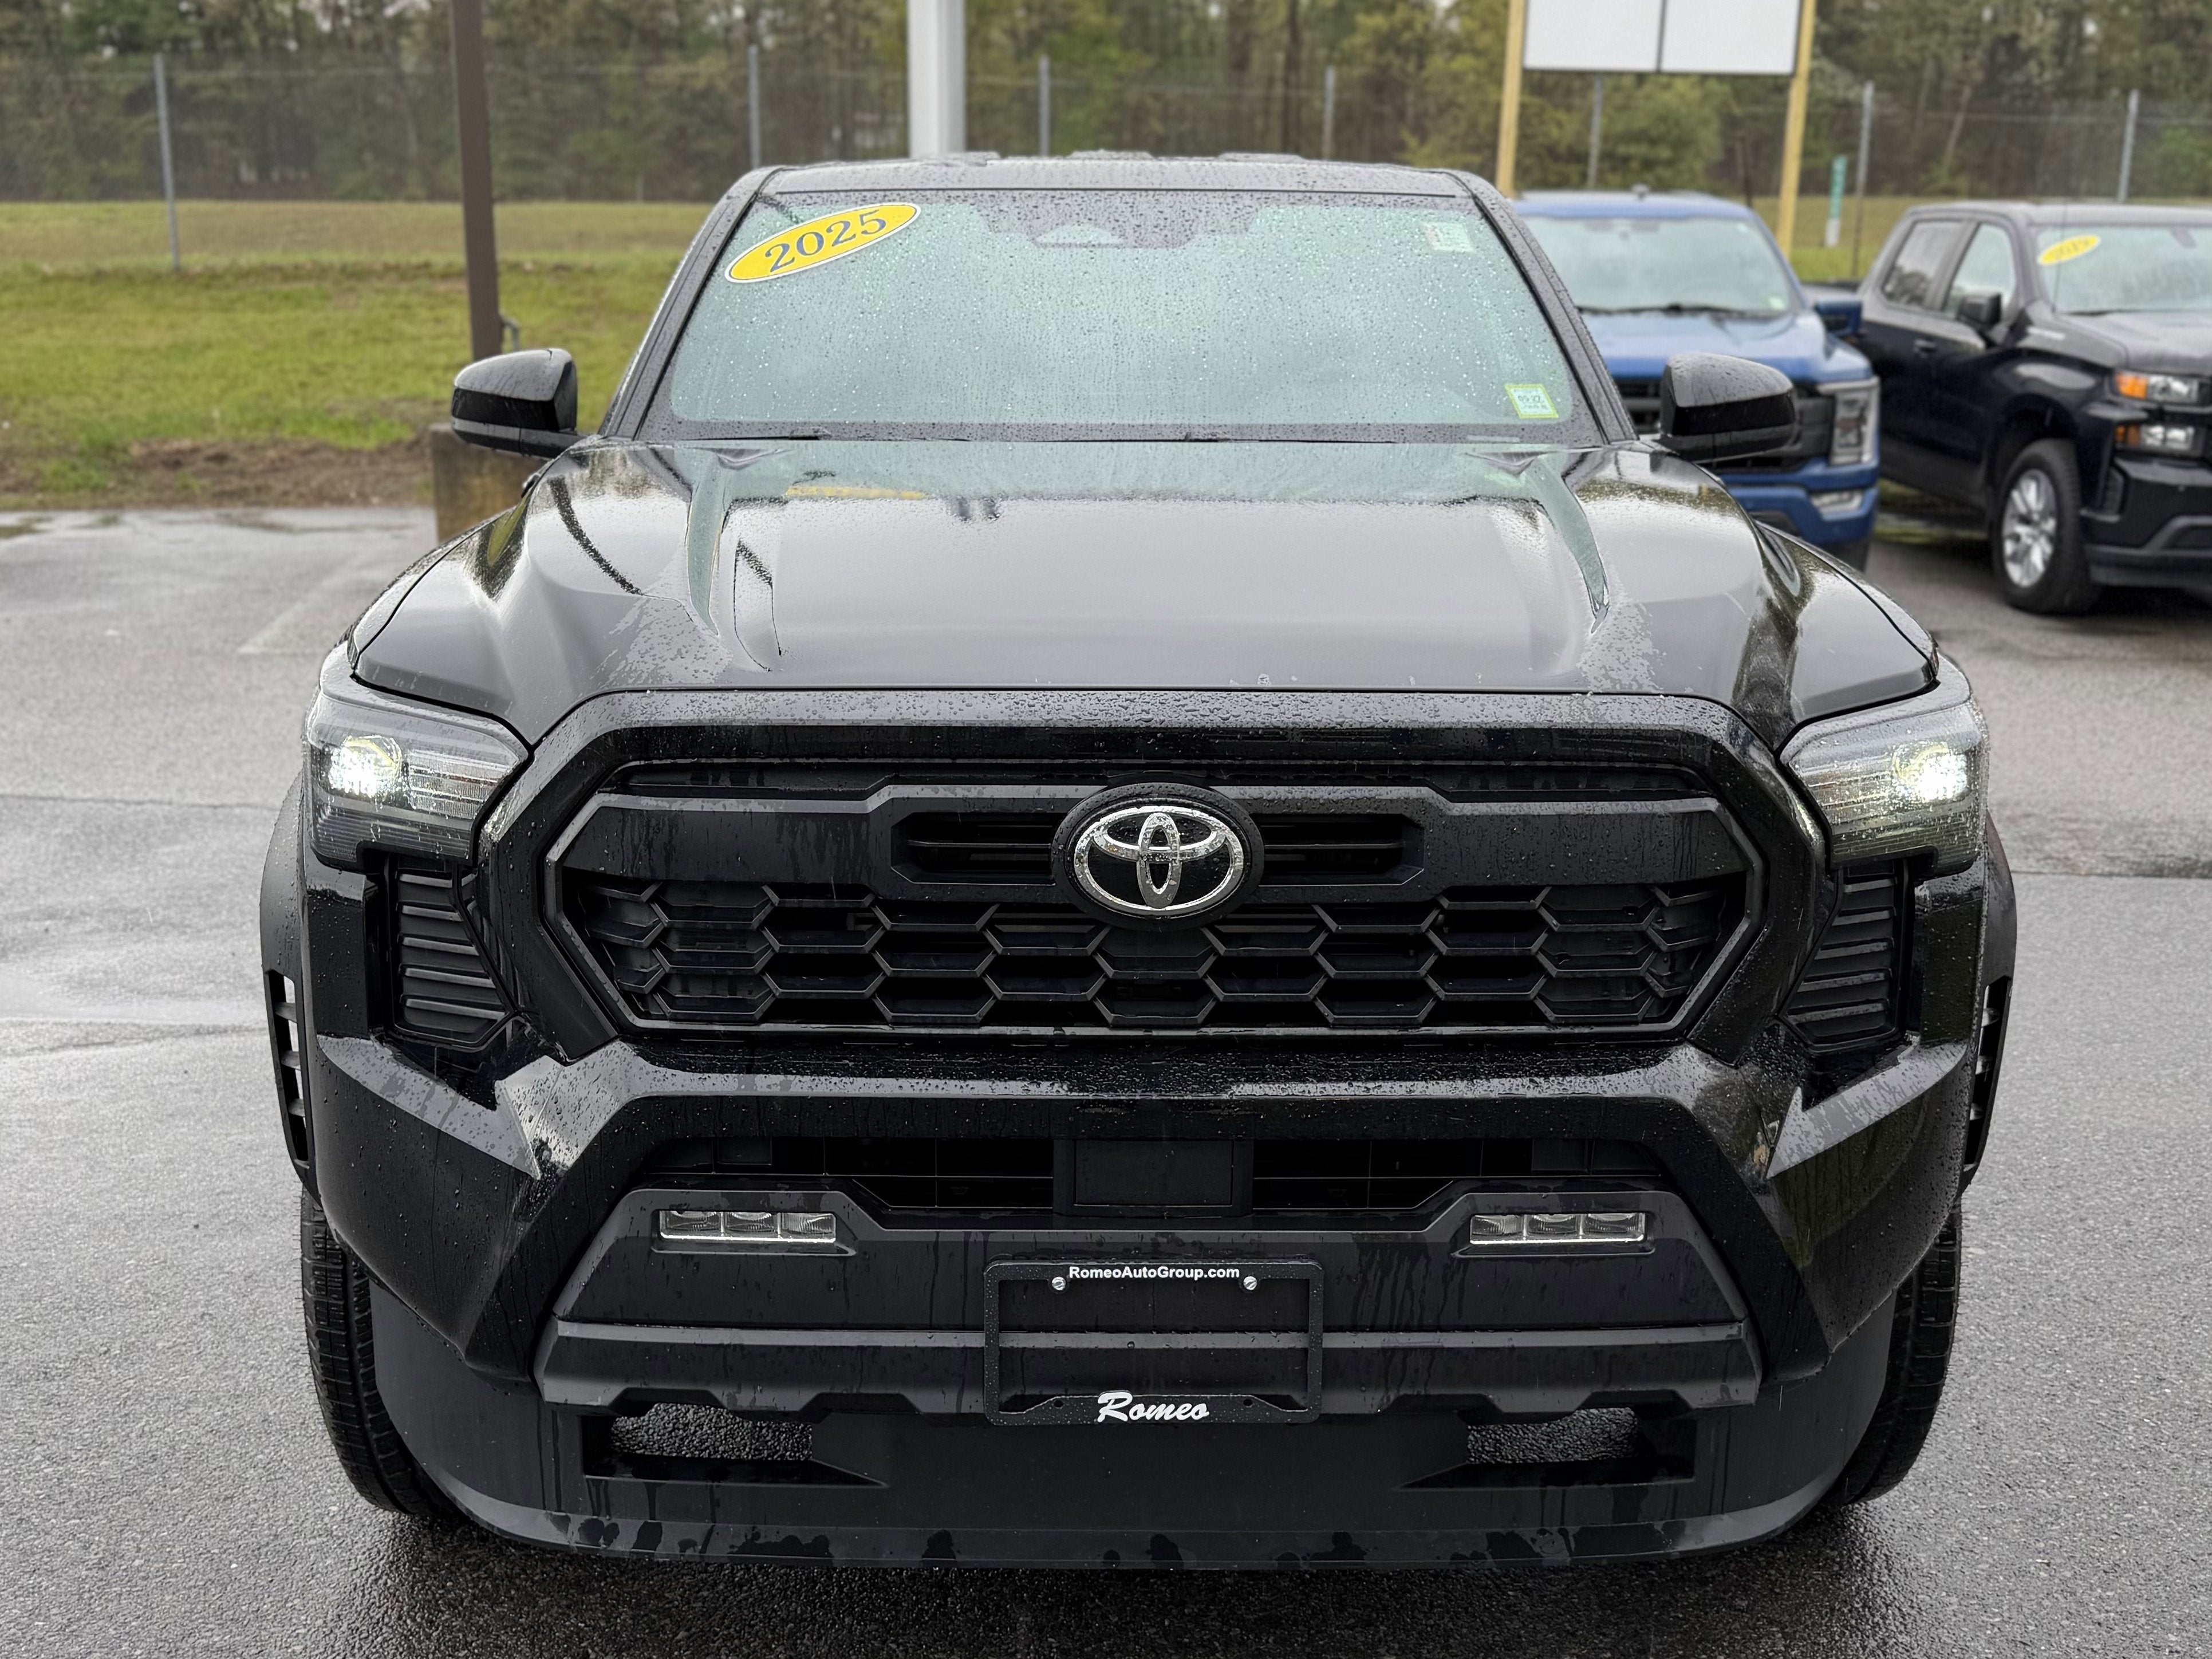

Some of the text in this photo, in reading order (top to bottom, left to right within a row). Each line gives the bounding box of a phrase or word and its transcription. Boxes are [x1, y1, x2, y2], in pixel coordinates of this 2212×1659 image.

[764, 208, 887, 273] 2025
[1068, 1266, 1240, 1280] RomeoAutoGroup.com
[1097, 1391, 1210, 1422] Romeo
